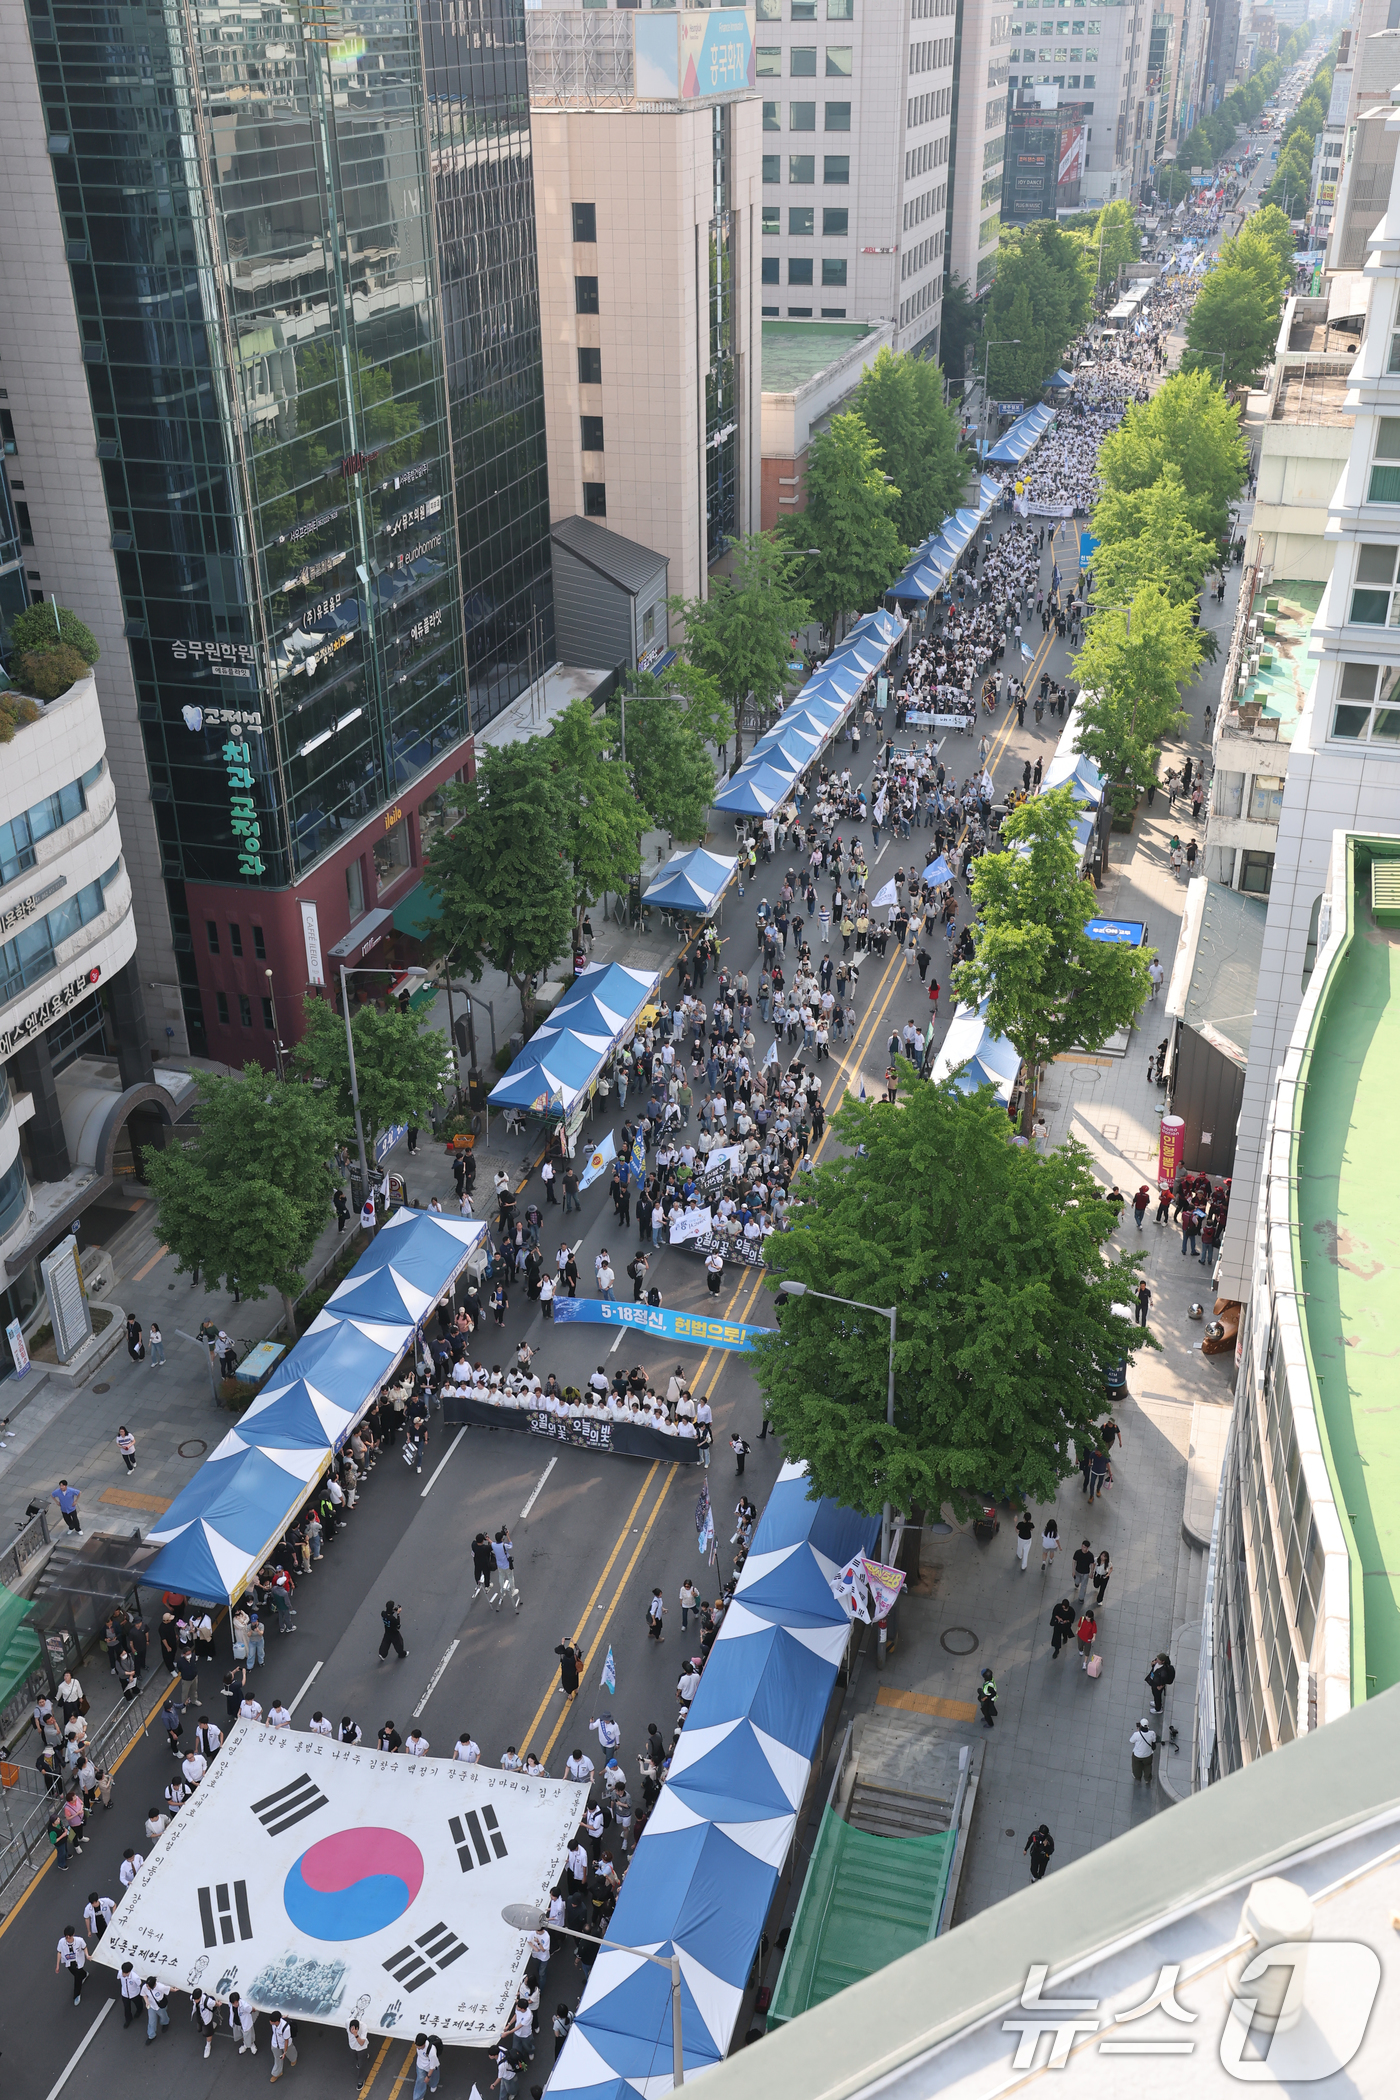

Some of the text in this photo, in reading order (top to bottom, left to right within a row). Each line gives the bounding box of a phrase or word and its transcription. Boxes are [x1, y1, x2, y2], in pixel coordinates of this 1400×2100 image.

[710, 41, 744, 86] 흥국화재
[1023, 117, 1044, 125] JOY
[404, 534, 442, 565] eurohomme
[410, 608, 442, 641] 에듀플라잇
[171, 639, 256, 664] 승무원학원
[213, 666, 248, 677] 에듀플라잇
[204, 708, 263, 736] 고정석
[1162, 1135, 1175, 1178] 인형뽑기
[694, 1231, 720, 1252] 오월의
[734, 1239, 758, 1262] 오늘의
[675, 1316, 747, 1345] 헌법으로!
[531, 1413, 556, 1434] 오월의
[572, 1419, 599, 1443] 오늘의
[600, 1424, 611, 1443] 빛
[258, 1732, 287, 1749] 김원봉
[294, 1741, 323, 1756] 홍범도
[332, 1750, 361, 1765] 나석주
[370, 1759, 399, 1772] 김창숙
[407, 1764, 439, 1778] 백정기
[447, 1769, 478, 1783] 장준하
[488, 1778, 530, 1794] 김마리아
[118, 1727, 248, 1927] 이회영 안창호 신채호 이상설 이동녕 강우규
[495, 1790, 581, 2015] 윤봉길 이봉창 남자현 김경천 한용운
[138, 1926, 164, 1942] 이육사
[110, 1936, 178, 1968] 민족문제연구소
[419, 2013, 497, 2032] 민족문제연구소
[458, 2001, 488, 2015] 윤세주
